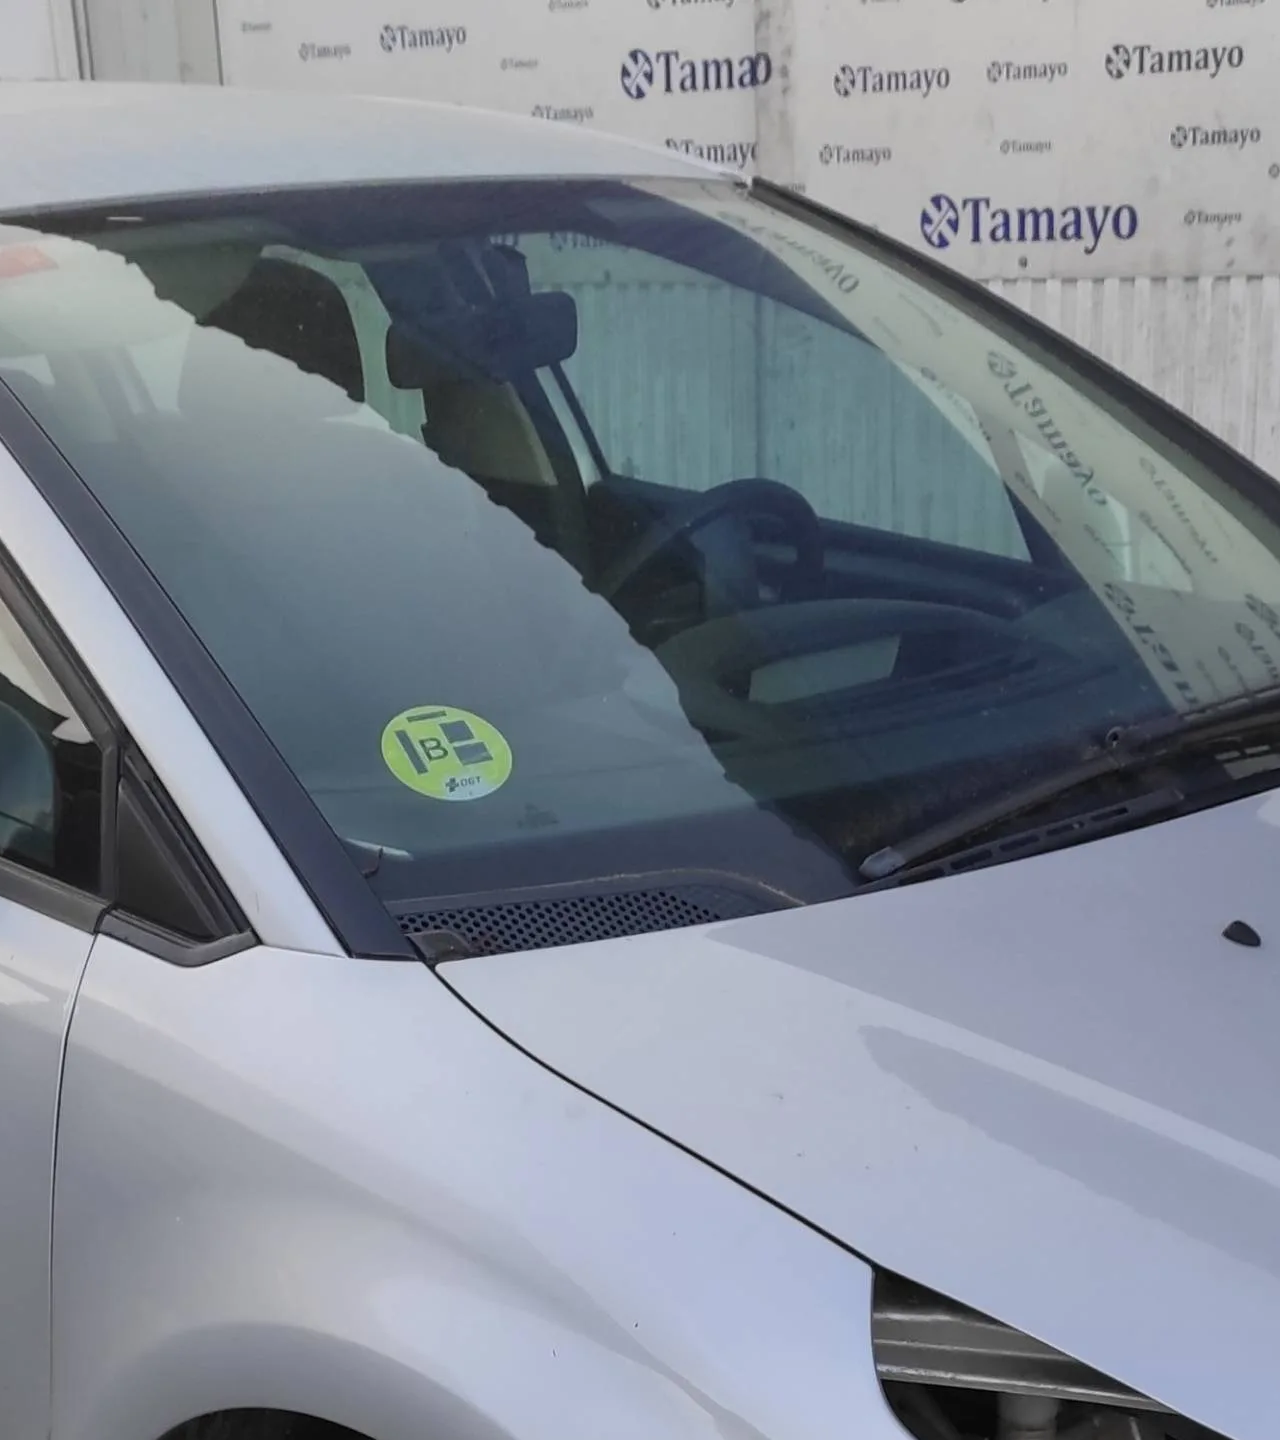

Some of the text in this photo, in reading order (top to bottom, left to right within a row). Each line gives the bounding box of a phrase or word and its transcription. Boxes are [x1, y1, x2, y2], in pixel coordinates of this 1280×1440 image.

[396, 25, 467, 52] Tamayo
[1002, 62, 1068, 82] Tamayo
[1133, 45, 1243, 78] Tamayo
[857, 66, 950, 98] Tamayo
[1188, 126, 1261, 150] Tamayo
[834, 146, 892, 166] Tamayo
[962, 198, 1138, 254] Tamayo
[419, 737, 449, 761] B
